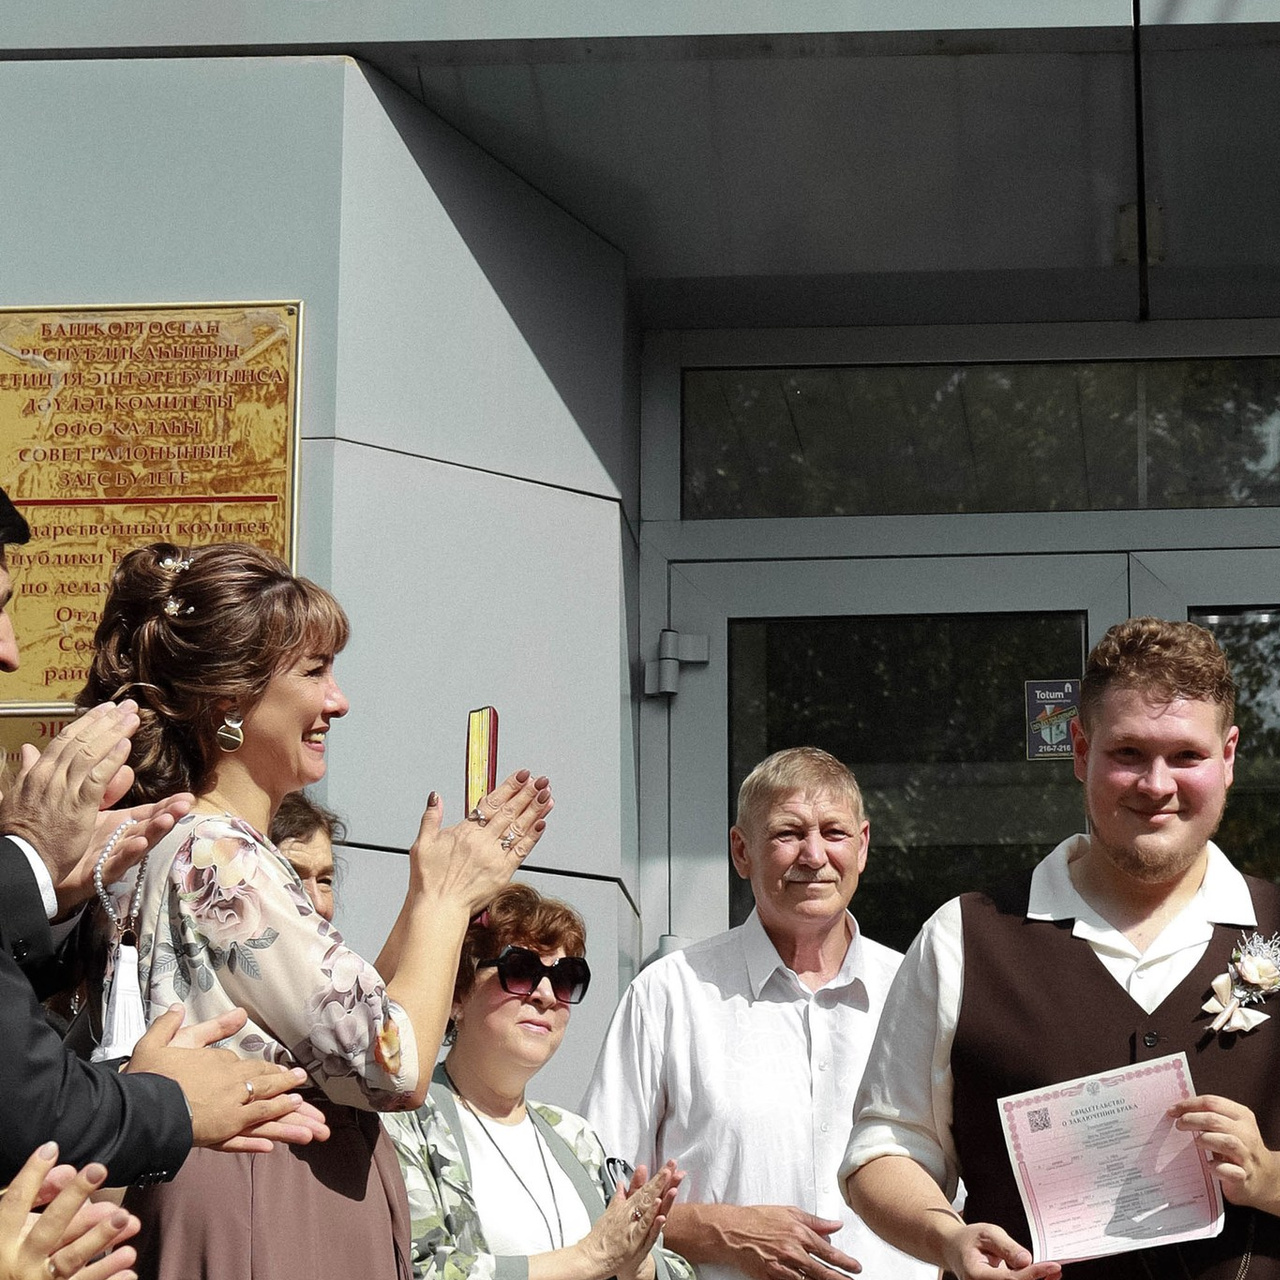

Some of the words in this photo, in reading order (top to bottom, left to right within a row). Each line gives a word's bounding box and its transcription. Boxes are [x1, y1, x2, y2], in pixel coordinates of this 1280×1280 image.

[113, 393, 235, 412] КОМИТЕТЫ
[18, 447, 85, 463] СОВЕТ
[60, 471, 111, 487] ЗАГС
[178, 521, 271, 536] комитет
[6, 549, 105, 572] публики
[20, 582, 49, 595] по
[1035, 690, 1064, 699] Totum
